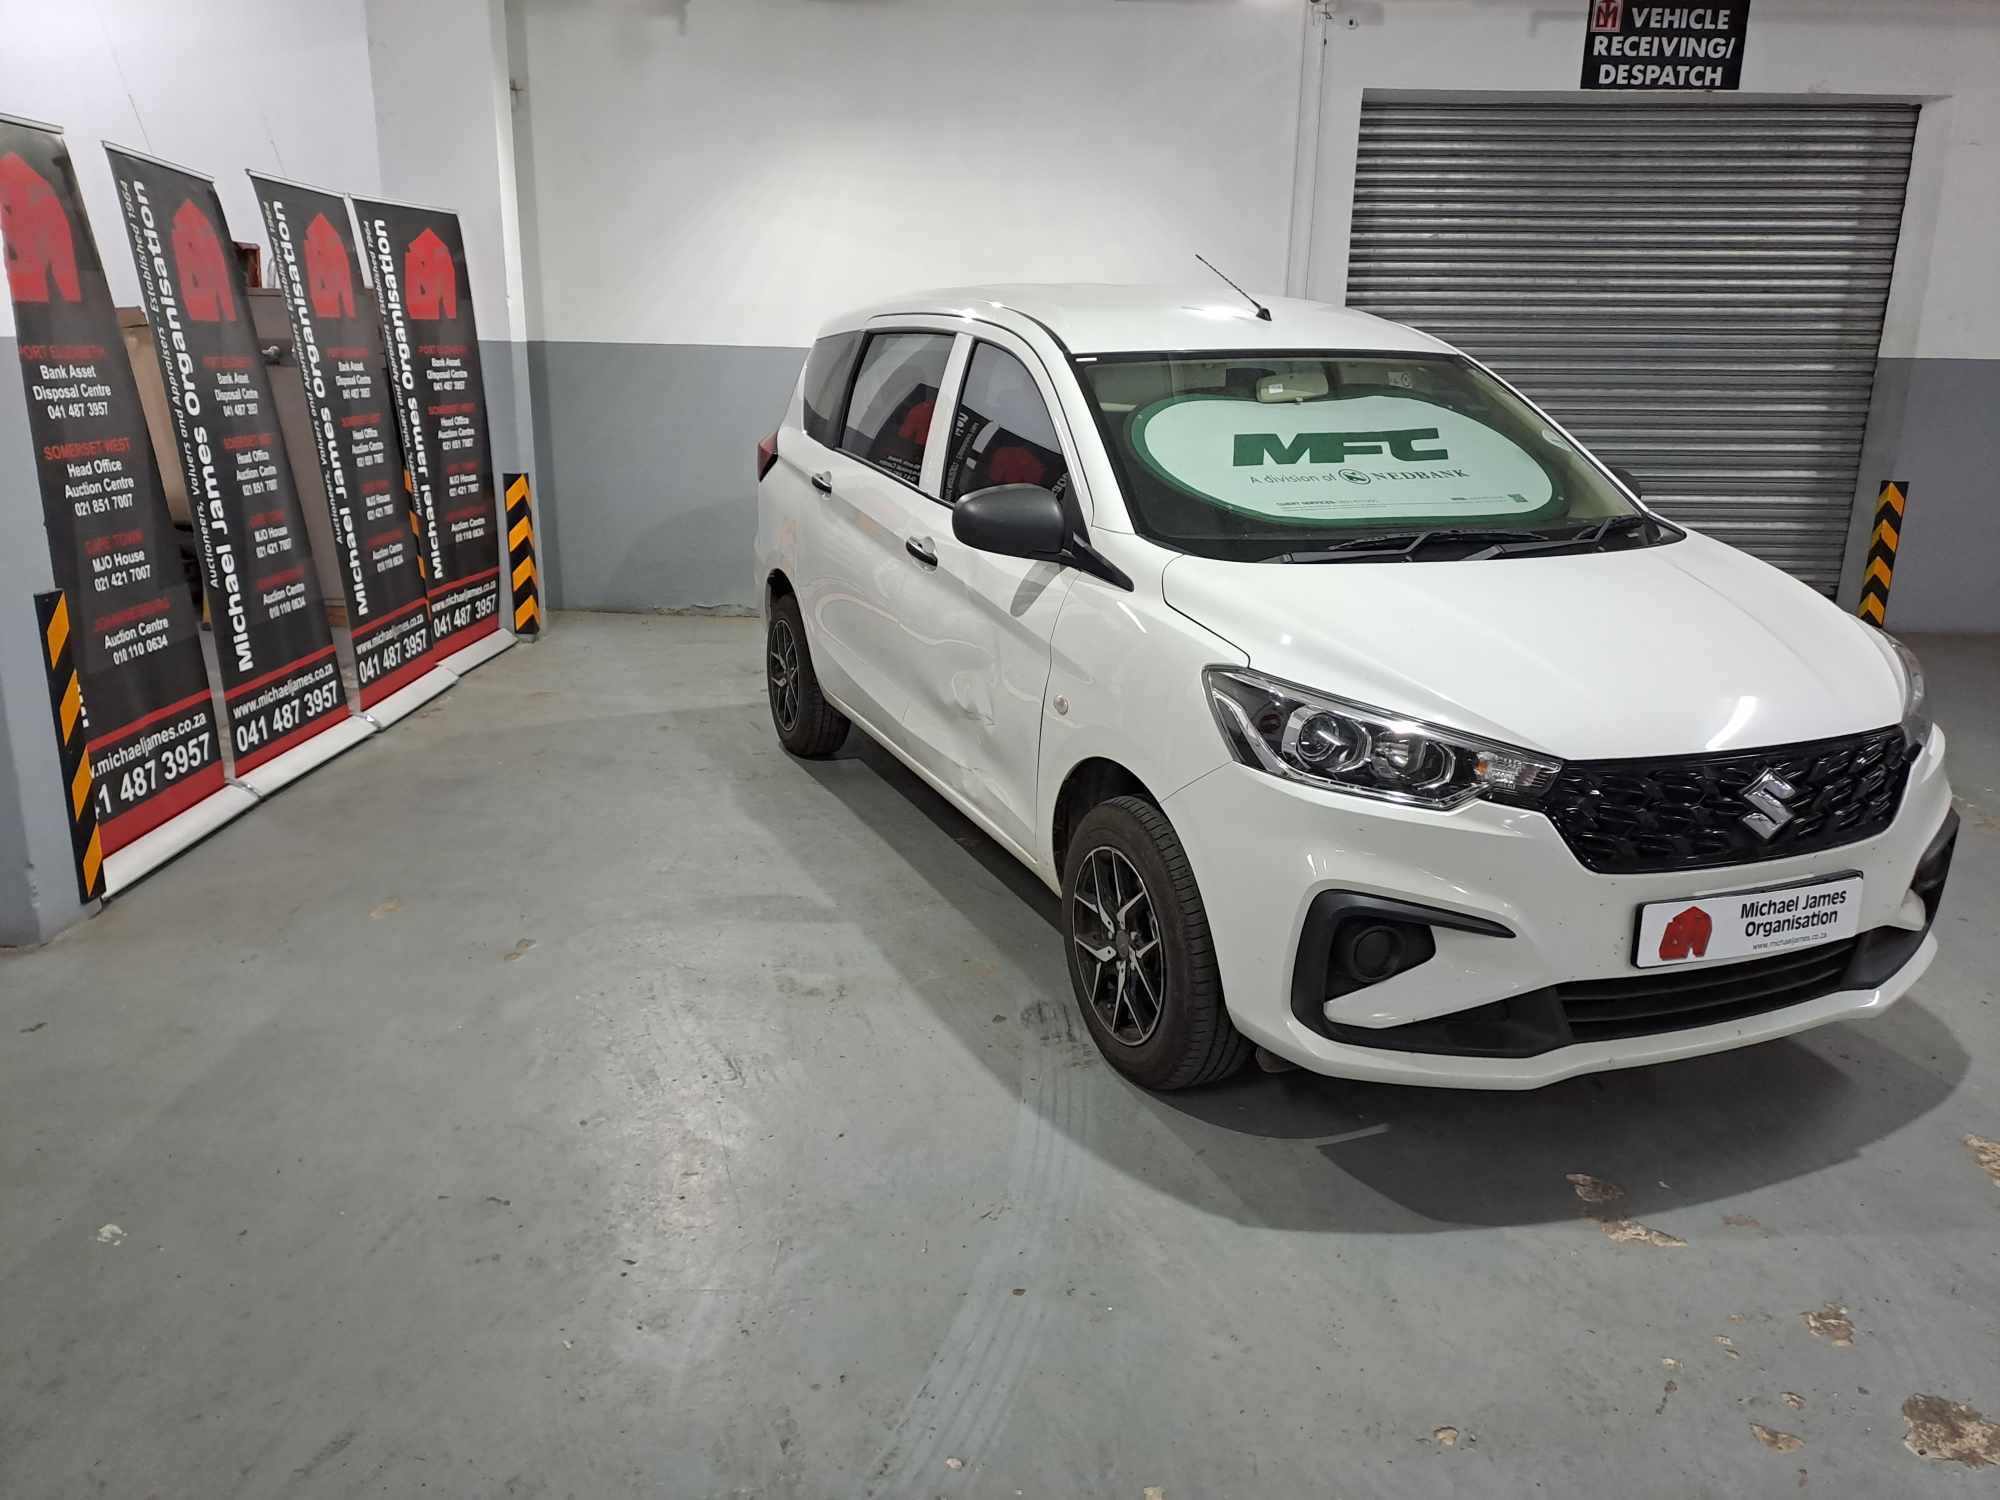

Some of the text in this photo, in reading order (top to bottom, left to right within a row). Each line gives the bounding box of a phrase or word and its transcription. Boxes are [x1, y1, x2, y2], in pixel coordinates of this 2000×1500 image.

[1632, 7, 1731, 30] VEHICLE
[1593, 35, 1736, 59] RECEIVING/
[1599, 64, 1723, 87] DESPATCH
[120, 180, 136, 219] 1964
[130, 223, 160, 313] Established
[273, 200, 326, 399] Organisation
[374, 219, 415, 390] Organisation
[40, 364, 96, 379] Bank Asset
[157, 326, 182, 406] Appraisers
[32, 383, 112, 402] Disposal Centre
[47, 402, 108, 419] 041 487 3957
[133, 180, 254, 672] Michael James Organisation
[175, 408, 188, 438] and
[320, 406, 348, 499] James
[407, 397, 429, 478] James
[1233, 427, 1449, 466] MFC
[67, 459, 122, 478] Head Office
[184, 441, 200, 495] Valuers
[1250, 469, 1470, 484] A division of NEDBANK
[65, 477, 134, 499] Auction Centre
[75, 494, 133, 517] 021 851 7007
[420, 484, 444, 579] Michael
[92, 550, 145, 573] MJO House
[94, 564, 151, 592] 021 421 7007
[338, 507, 369, 616] Michael
[104, 617, 169, 649] Auction Centre
[433, 594, 497, 638] 041 487 3957
[129, 643, 145, 659] 110
[359, 628, 427, 683] 041 487 3957
[232, 663, 334, 720] www.michaeljames.co.za
[236, 680, 339, 752] 041 487 3957
[119, 759, 158, 802] 487
[161, 732, 211, 780] 3957
[1741, 889, 1847, 919] Michael James
[1745, 909, 1838, 938] Organisation
